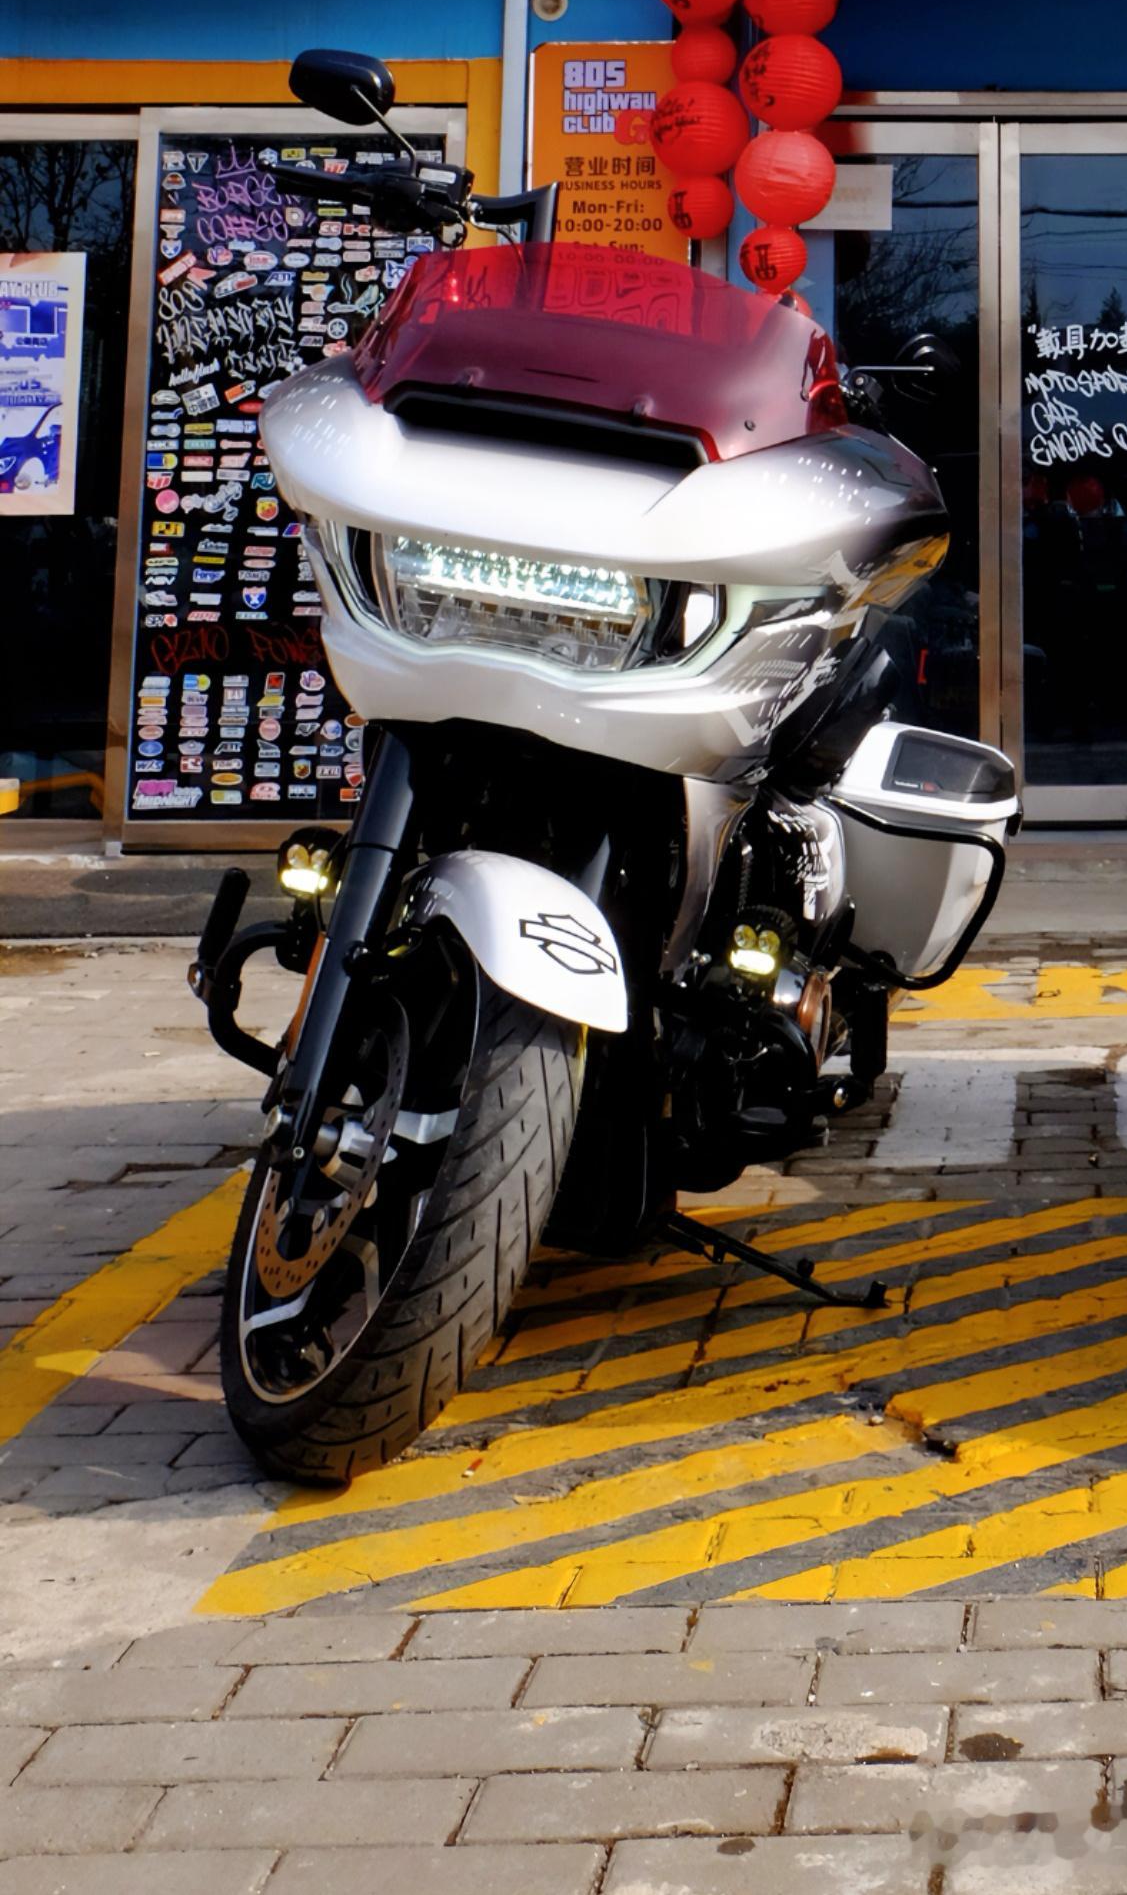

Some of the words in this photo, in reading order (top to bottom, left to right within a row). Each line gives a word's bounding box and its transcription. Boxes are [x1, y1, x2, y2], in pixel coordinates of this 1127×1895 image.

[563, 60, 626, 88] 80S
[563, 111, 616, 134] club
[564, 157, 656, 177] 营业时间
[620, 180, 662, 191] HOURS
[572, 200, 645, 214] Mon-Fri:
[556, 218, 663, 232] 10:00-20:00
